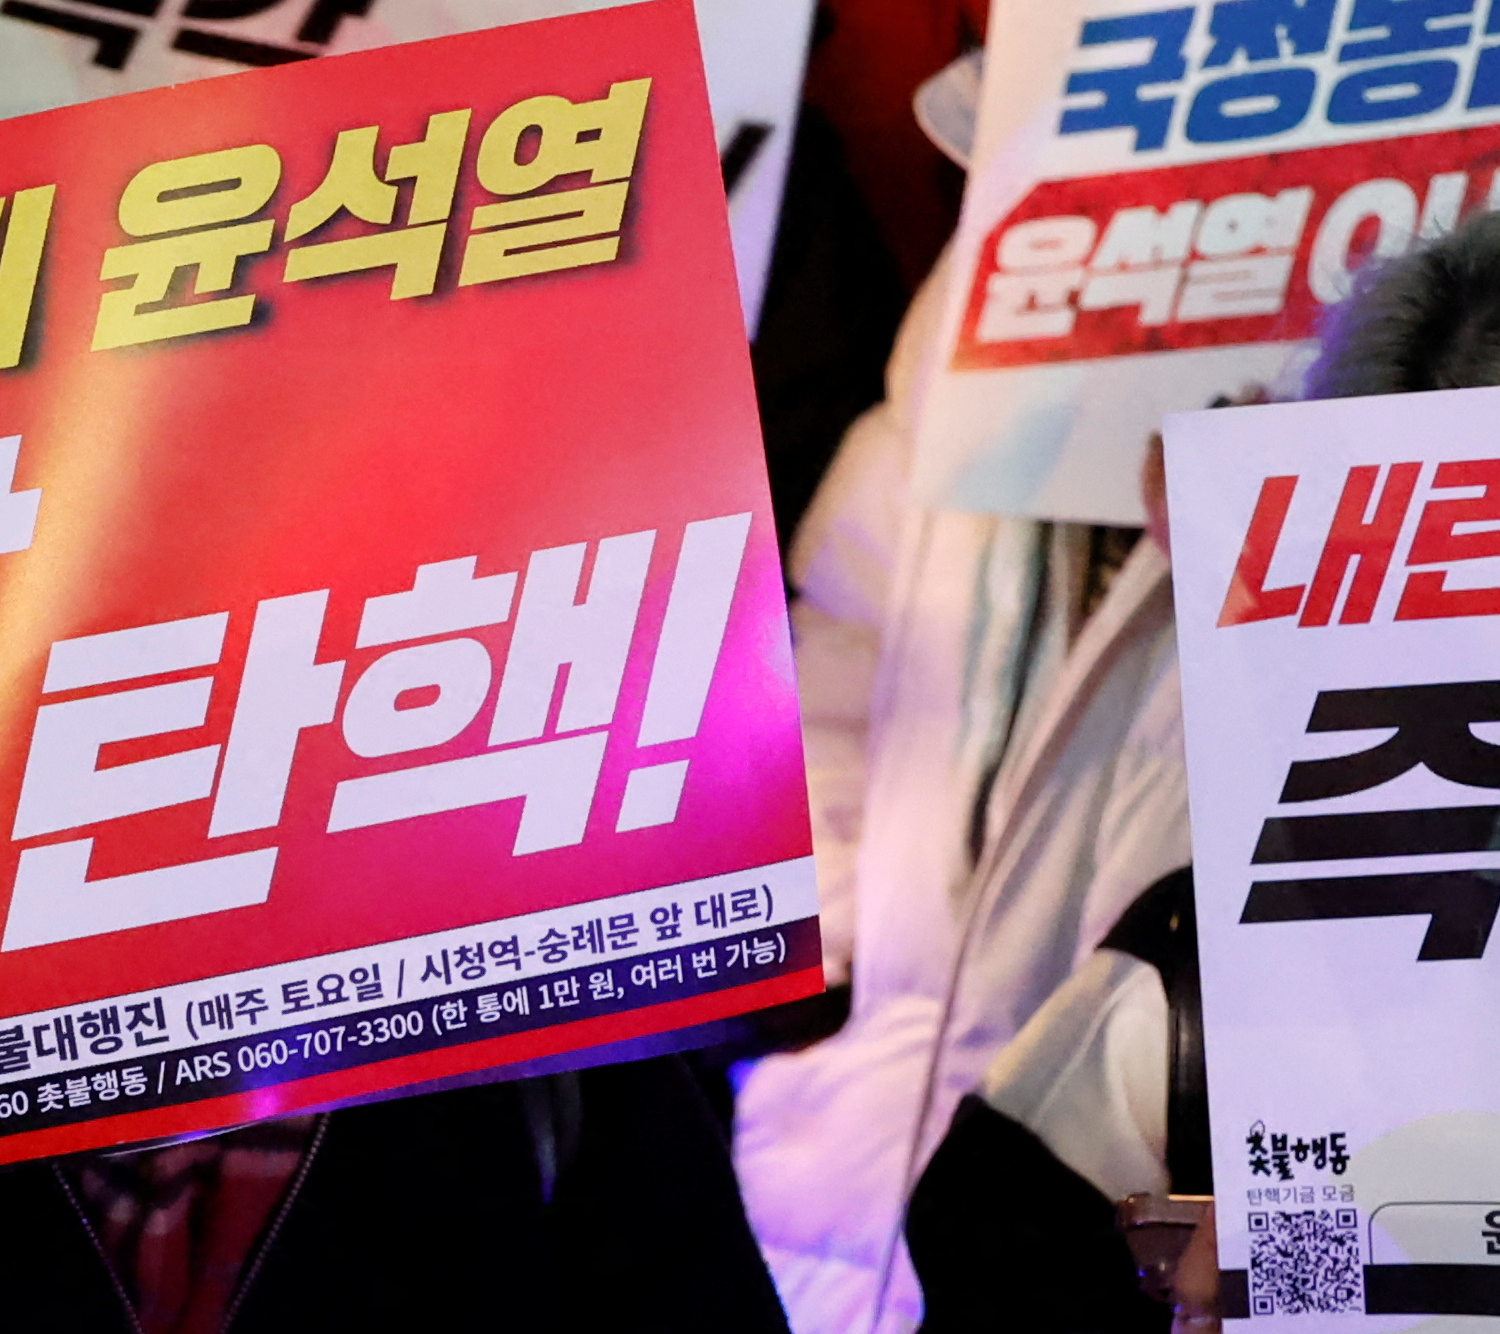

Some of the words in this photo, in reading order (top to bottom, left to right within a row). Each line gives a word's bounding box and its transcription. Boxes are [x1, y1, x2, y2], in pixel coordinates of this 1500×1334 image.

[90, 77, 654, 352] 윤석열
[975, 185, 1315, 343] 윤석열
[0, 511, 752, 953] 탄핵!
[36, 1065, 149, 1113] 촛불행동
[175, 1051, 232, 1087] ARS
[236, 1010, 424, 1073] 060-707-3300
[431, 1001, 469, 1036] (한
[474, 991, 531, 1025] 통에
[538, 981, 581, 1011] 1만
[588, 971, 625, 1003] 원,
[631, 960, 684, 991] 여러
[691, 950, 718, 980] 번
[725, 932, 788, 970] 가능)
[186, 987, 270, 1041] (매주
[281, 963, 384, 1015] 토요일
[419, 910, 640, 989] 시청역-숭례문
[649, 903, 684, 941] 앞
[694, 883, 774, 931] 대로)
